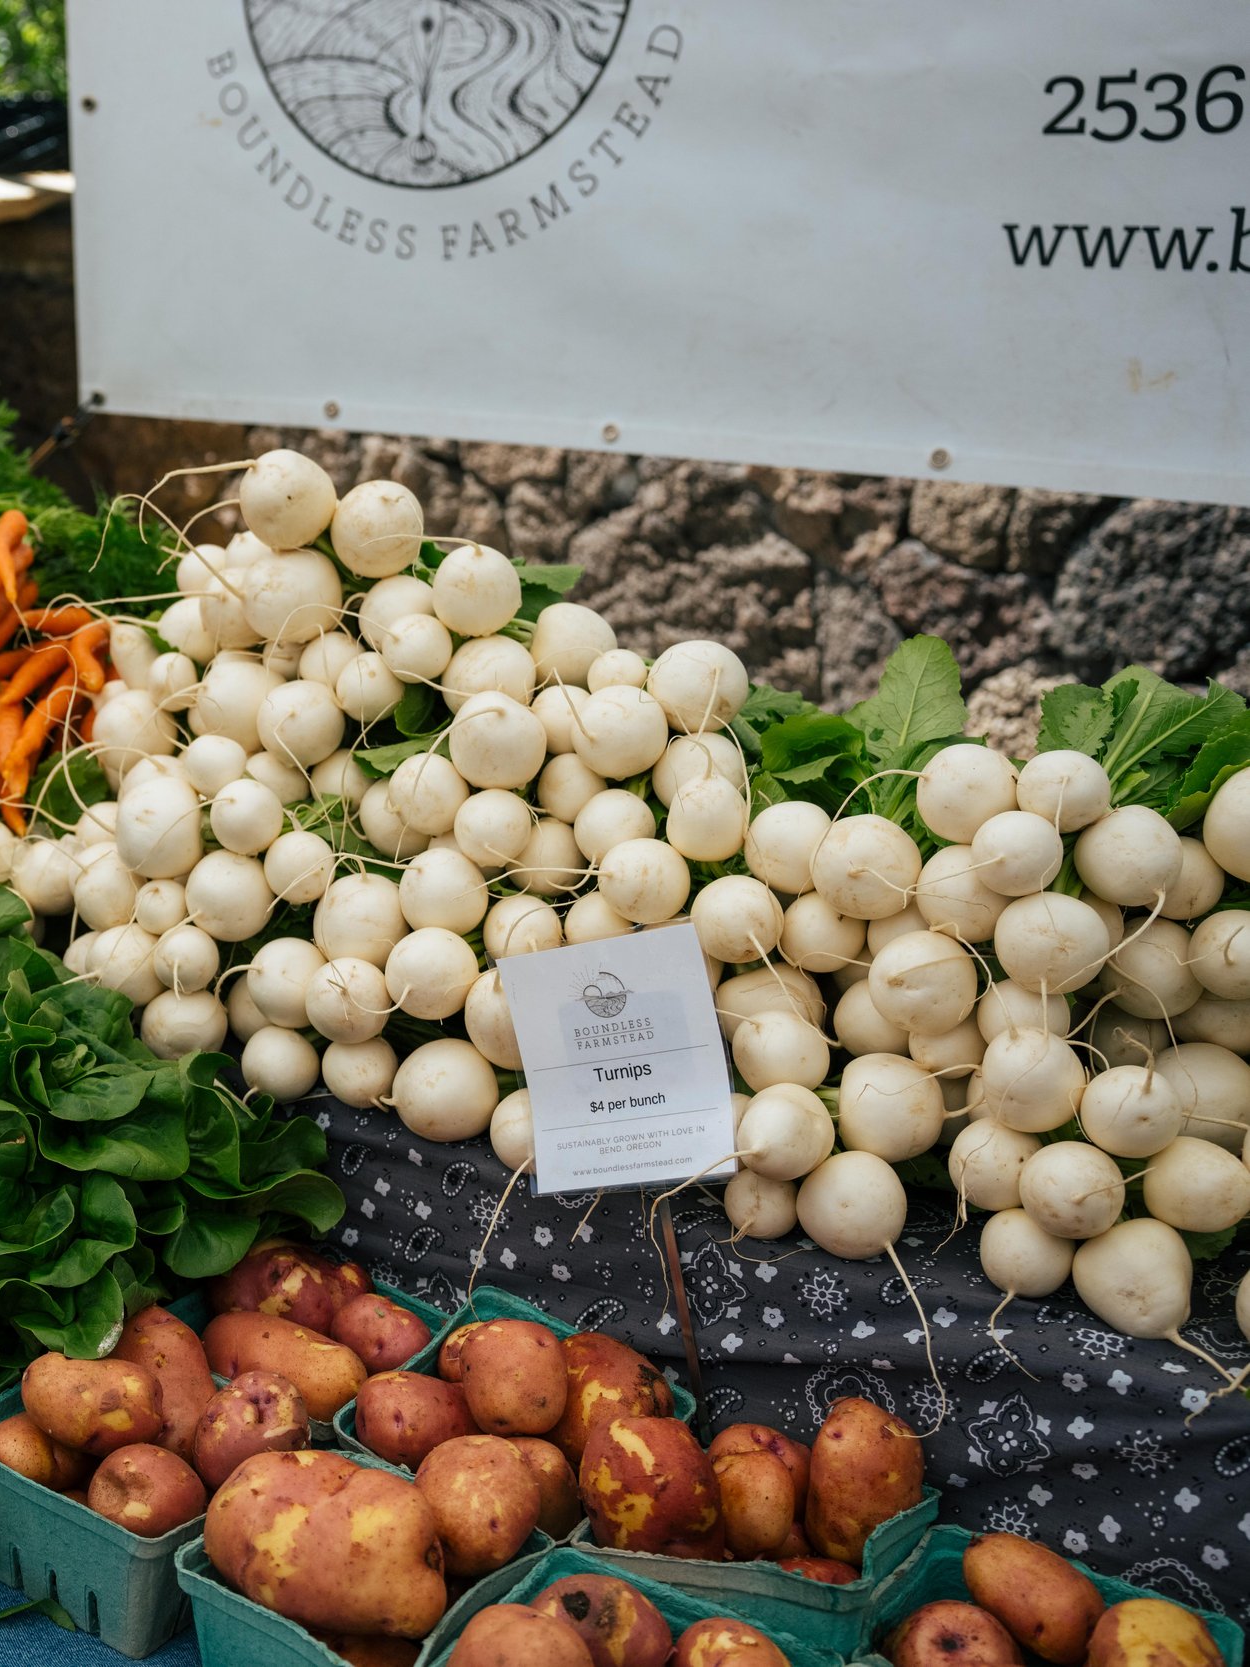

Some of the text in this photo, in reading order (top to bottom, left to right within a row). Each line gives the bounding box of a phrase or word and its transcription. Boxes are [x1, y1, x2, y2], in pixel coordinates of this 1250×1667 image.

[1042, 64, 1247, 142] 2536
[207, 23, 684, 261] BOUNDLESS FARMSTEAD
[574, 1017, 651, 1038] BOUNDLESS
[577, 1030, 654, 1050] FARMSTEAD
[593, 1062, 652, 1082] Turnips
[590, 1092, 666, 1113] $4 per bunch
[557, 1136, 611, 1150] SUSTAINABLY
[613, 1133, 645, 1144] GROWN
[647, 1130, 669, 1139] WITH
[671, 1126, 693, 1136] LOVE
[626, 1141, 661, 1151] OREGON
[573, 1157, 692, 1176] www.boundlessfarmstead.com
